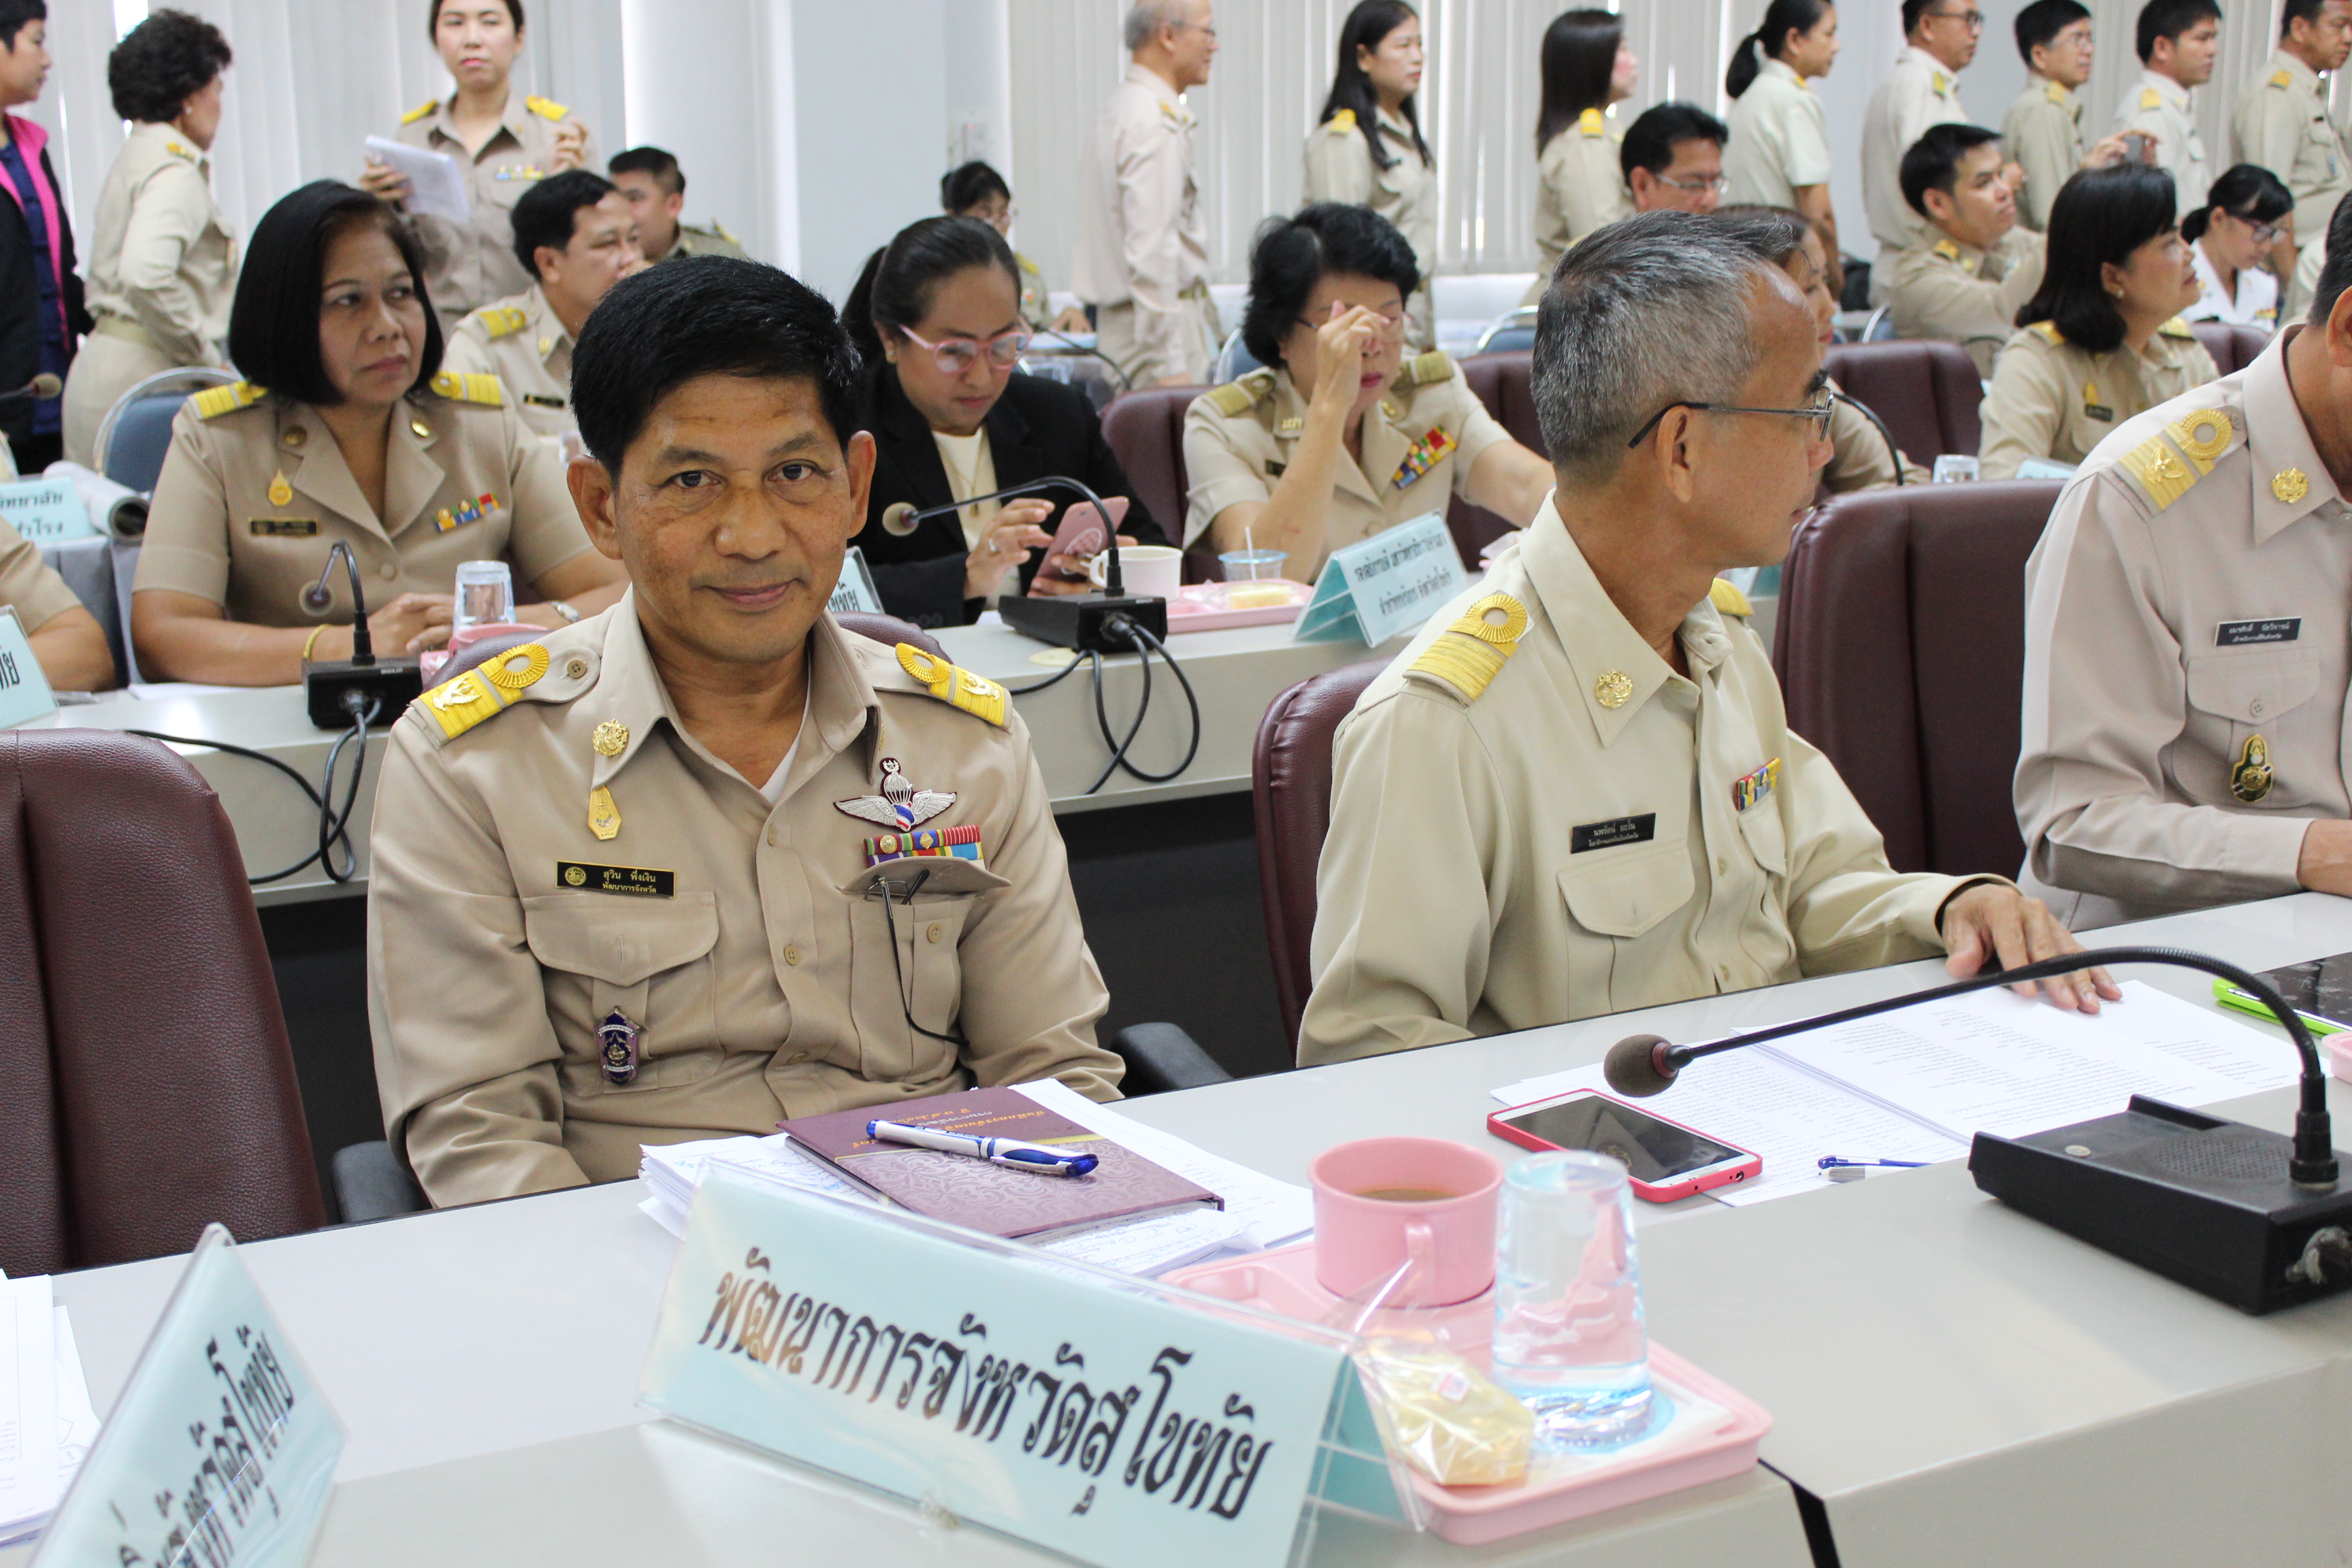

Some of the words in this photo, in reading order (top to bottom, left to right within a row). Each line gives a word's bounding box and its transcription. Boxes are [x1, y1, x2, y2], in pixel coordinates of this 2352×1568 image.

[603, 868, 621, 881] สุวิน
[602, 881, 657, 894] พัฒนาการจังหวัด
[698, 1246, 1275, 1521] พัฒนาการจังหวัดสุโขทัย
